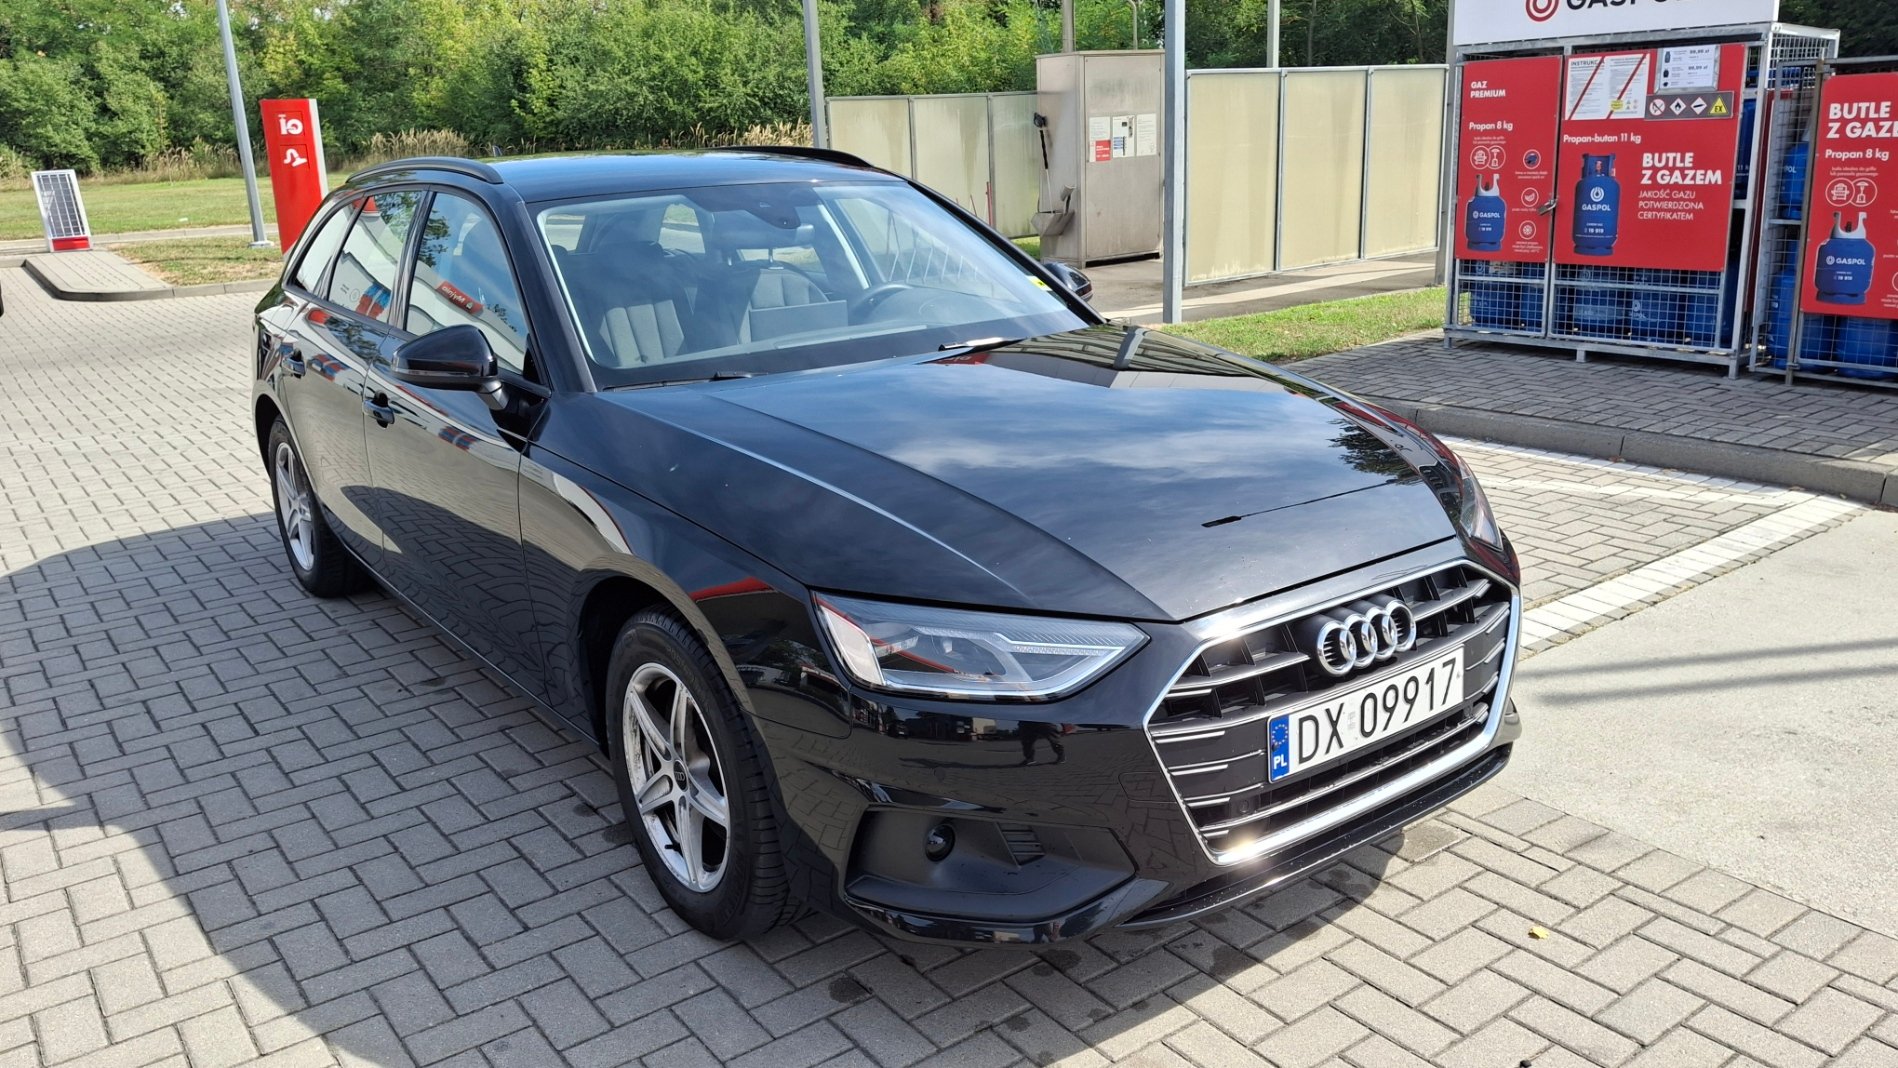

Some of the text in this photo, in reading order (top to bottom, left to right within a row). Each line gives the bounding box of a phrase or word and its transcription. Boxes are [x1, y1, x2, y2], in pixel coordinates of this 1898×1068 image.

[1471, 81, 1487, 89] GAZ
[1470, 89, 1506, 98] PREMIUM
[1829, 102, 1891, 119] BUTLE
[1469, 121, 1513, 131] Propan 8 kg
[1826, 122, 1841, 138] Z
[1563, 131, 1641, 144] Propan-butan 11 kg
[1825, 148, 1889, 161] Propan 8 kg
[1642, 153, 1694, 168] BUTLE
[1640, 170, 1722, 185] Z GAZEM
[1638, 189, 1696, 199] JAKOŚĆ GAZU
[1582, 203, 1611, 211] GASPOL
[1638, 201, 1704, 210] POTWIERDZONA
[1479, 211, 1500, 219] GASPOL
[1638, 211, 1694, 220] CERTYFIKATEM
[1836, 257, 1866, 266] GASPOL
[1298, 657, 1456, 765] DX 09917
[1273, 754, 1287, 770] PL
